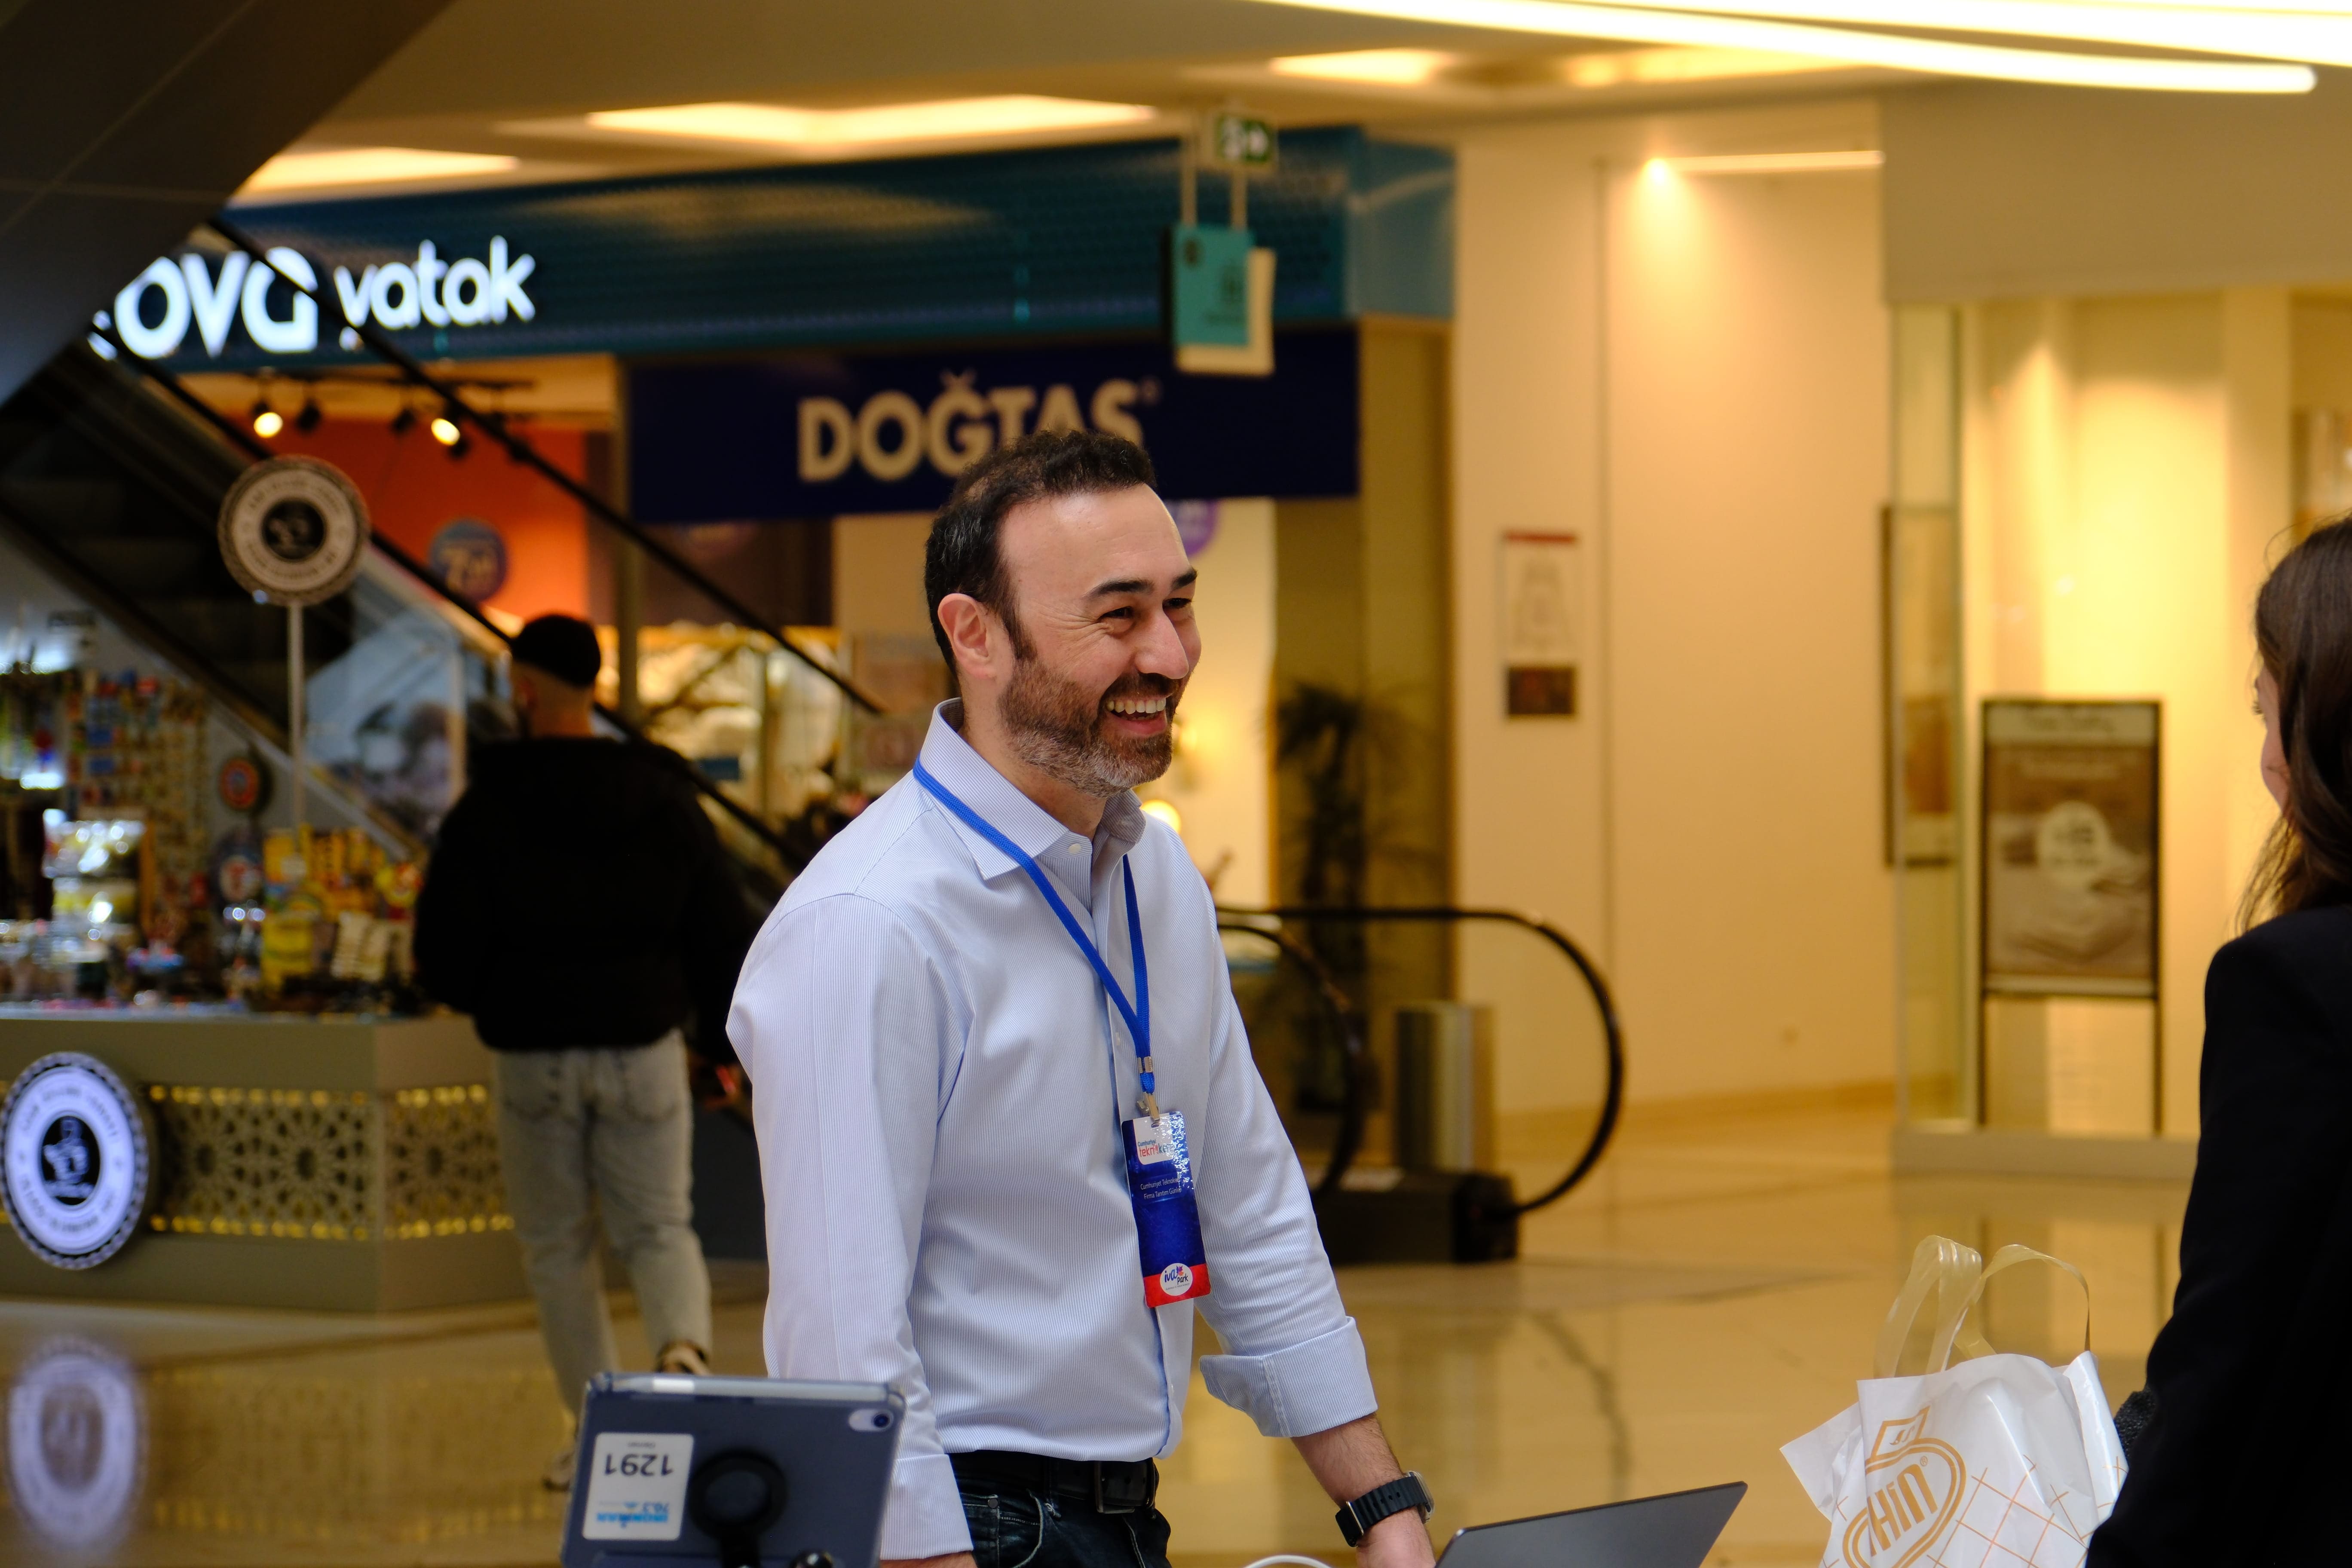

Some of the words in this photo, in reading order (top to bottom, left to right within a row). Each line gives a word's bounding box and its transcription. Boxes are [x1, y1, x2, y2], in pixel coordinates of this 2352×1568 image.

[1140, 1181, 1162, 1190] Cumhuriyet
[1177, 1273, 1188, 1285] park
[604, 1453, 674, 1476] 1291
